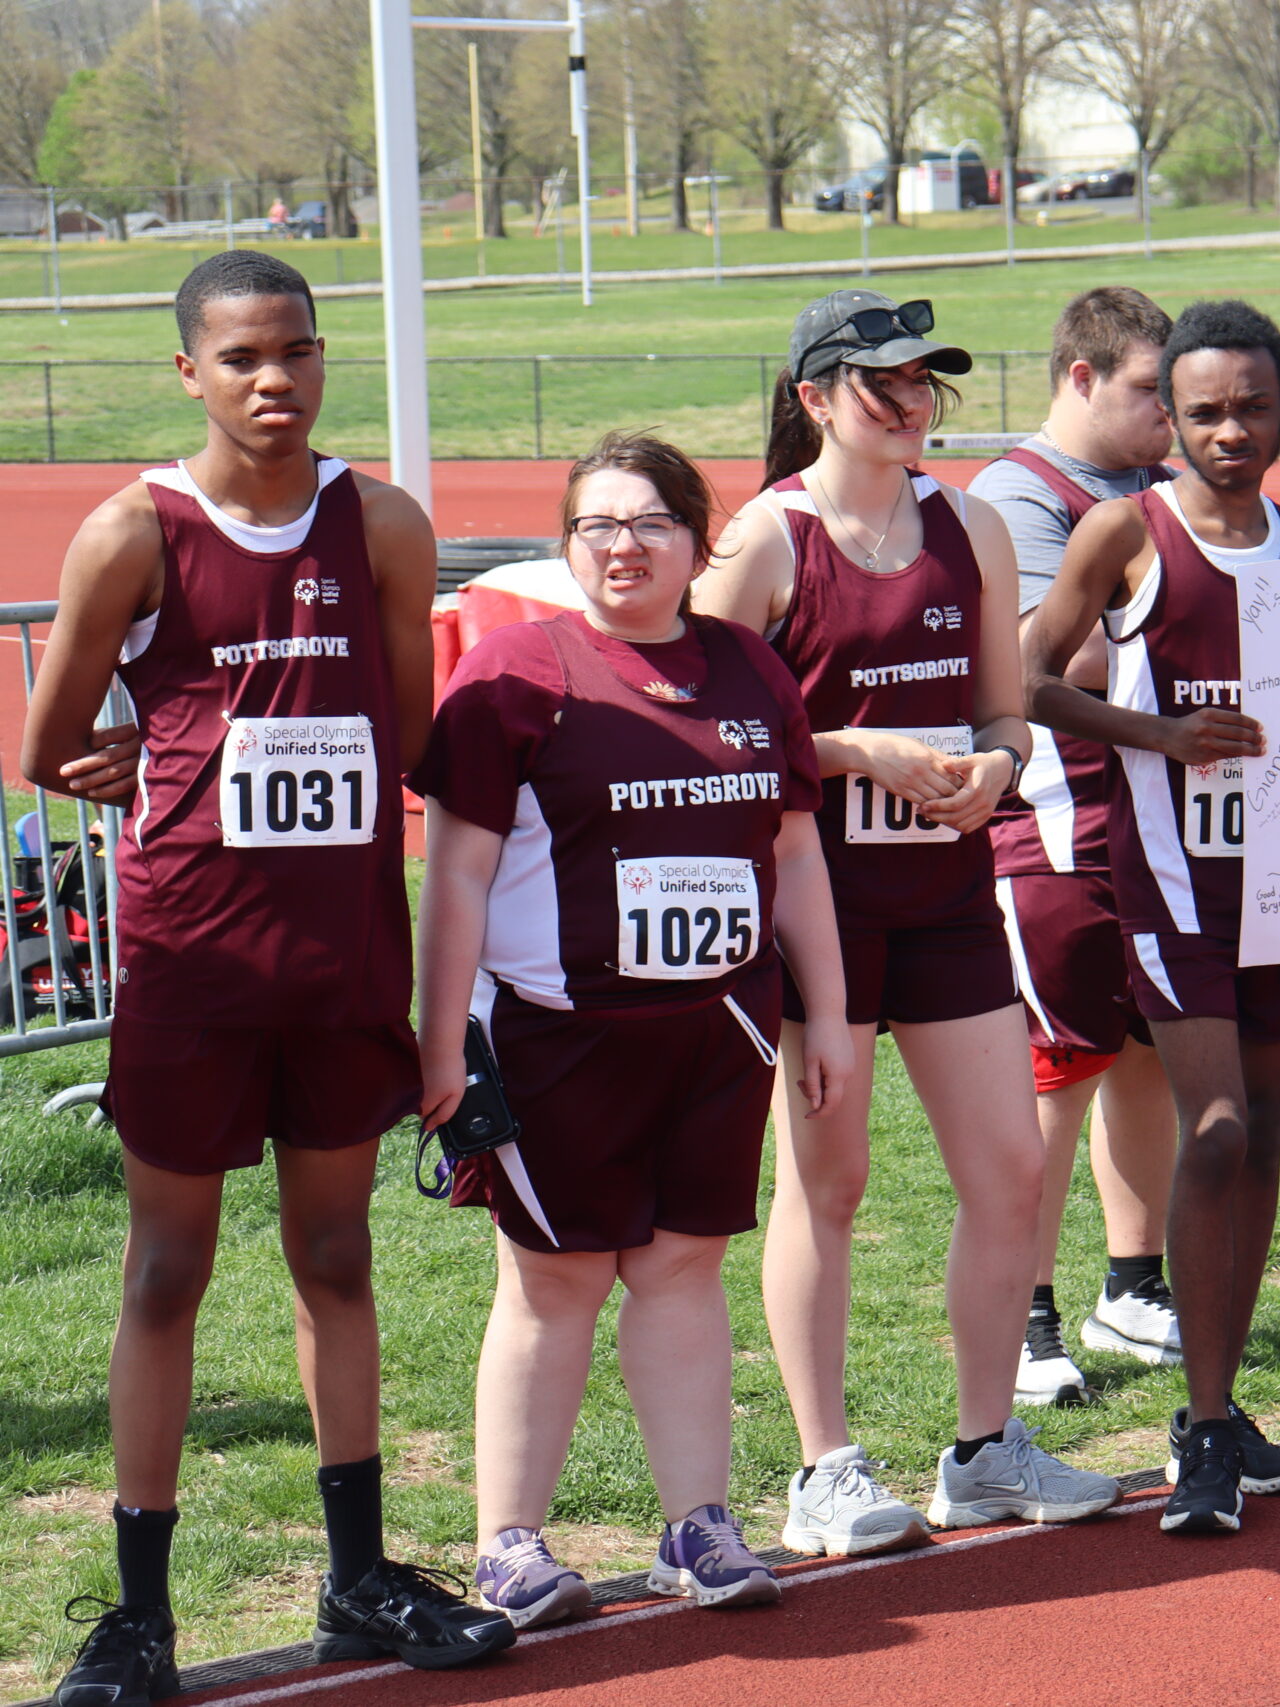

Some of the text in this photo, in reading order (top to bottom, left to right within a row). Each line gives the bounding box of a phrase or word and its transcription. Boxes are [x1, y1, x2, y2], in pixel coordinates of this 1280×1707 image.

[211, 636, 350, 667] POTTSGROVE
[850, 657, 969, 688] POTTSGROVE
[264, 725, 370, 741] Special Olympics
[927, 734, 970, 749] Olympics
[265, 742, 366, 757] Unified Sports
[230, 769, 363, 833] 1031
[608, 772, 780, 812] POTTSGROVE
[658, 864, 749, 879] Special Olympics
[660, 880, 747, 895] Unified Sports
[627, 907, 753, 967] 1025
